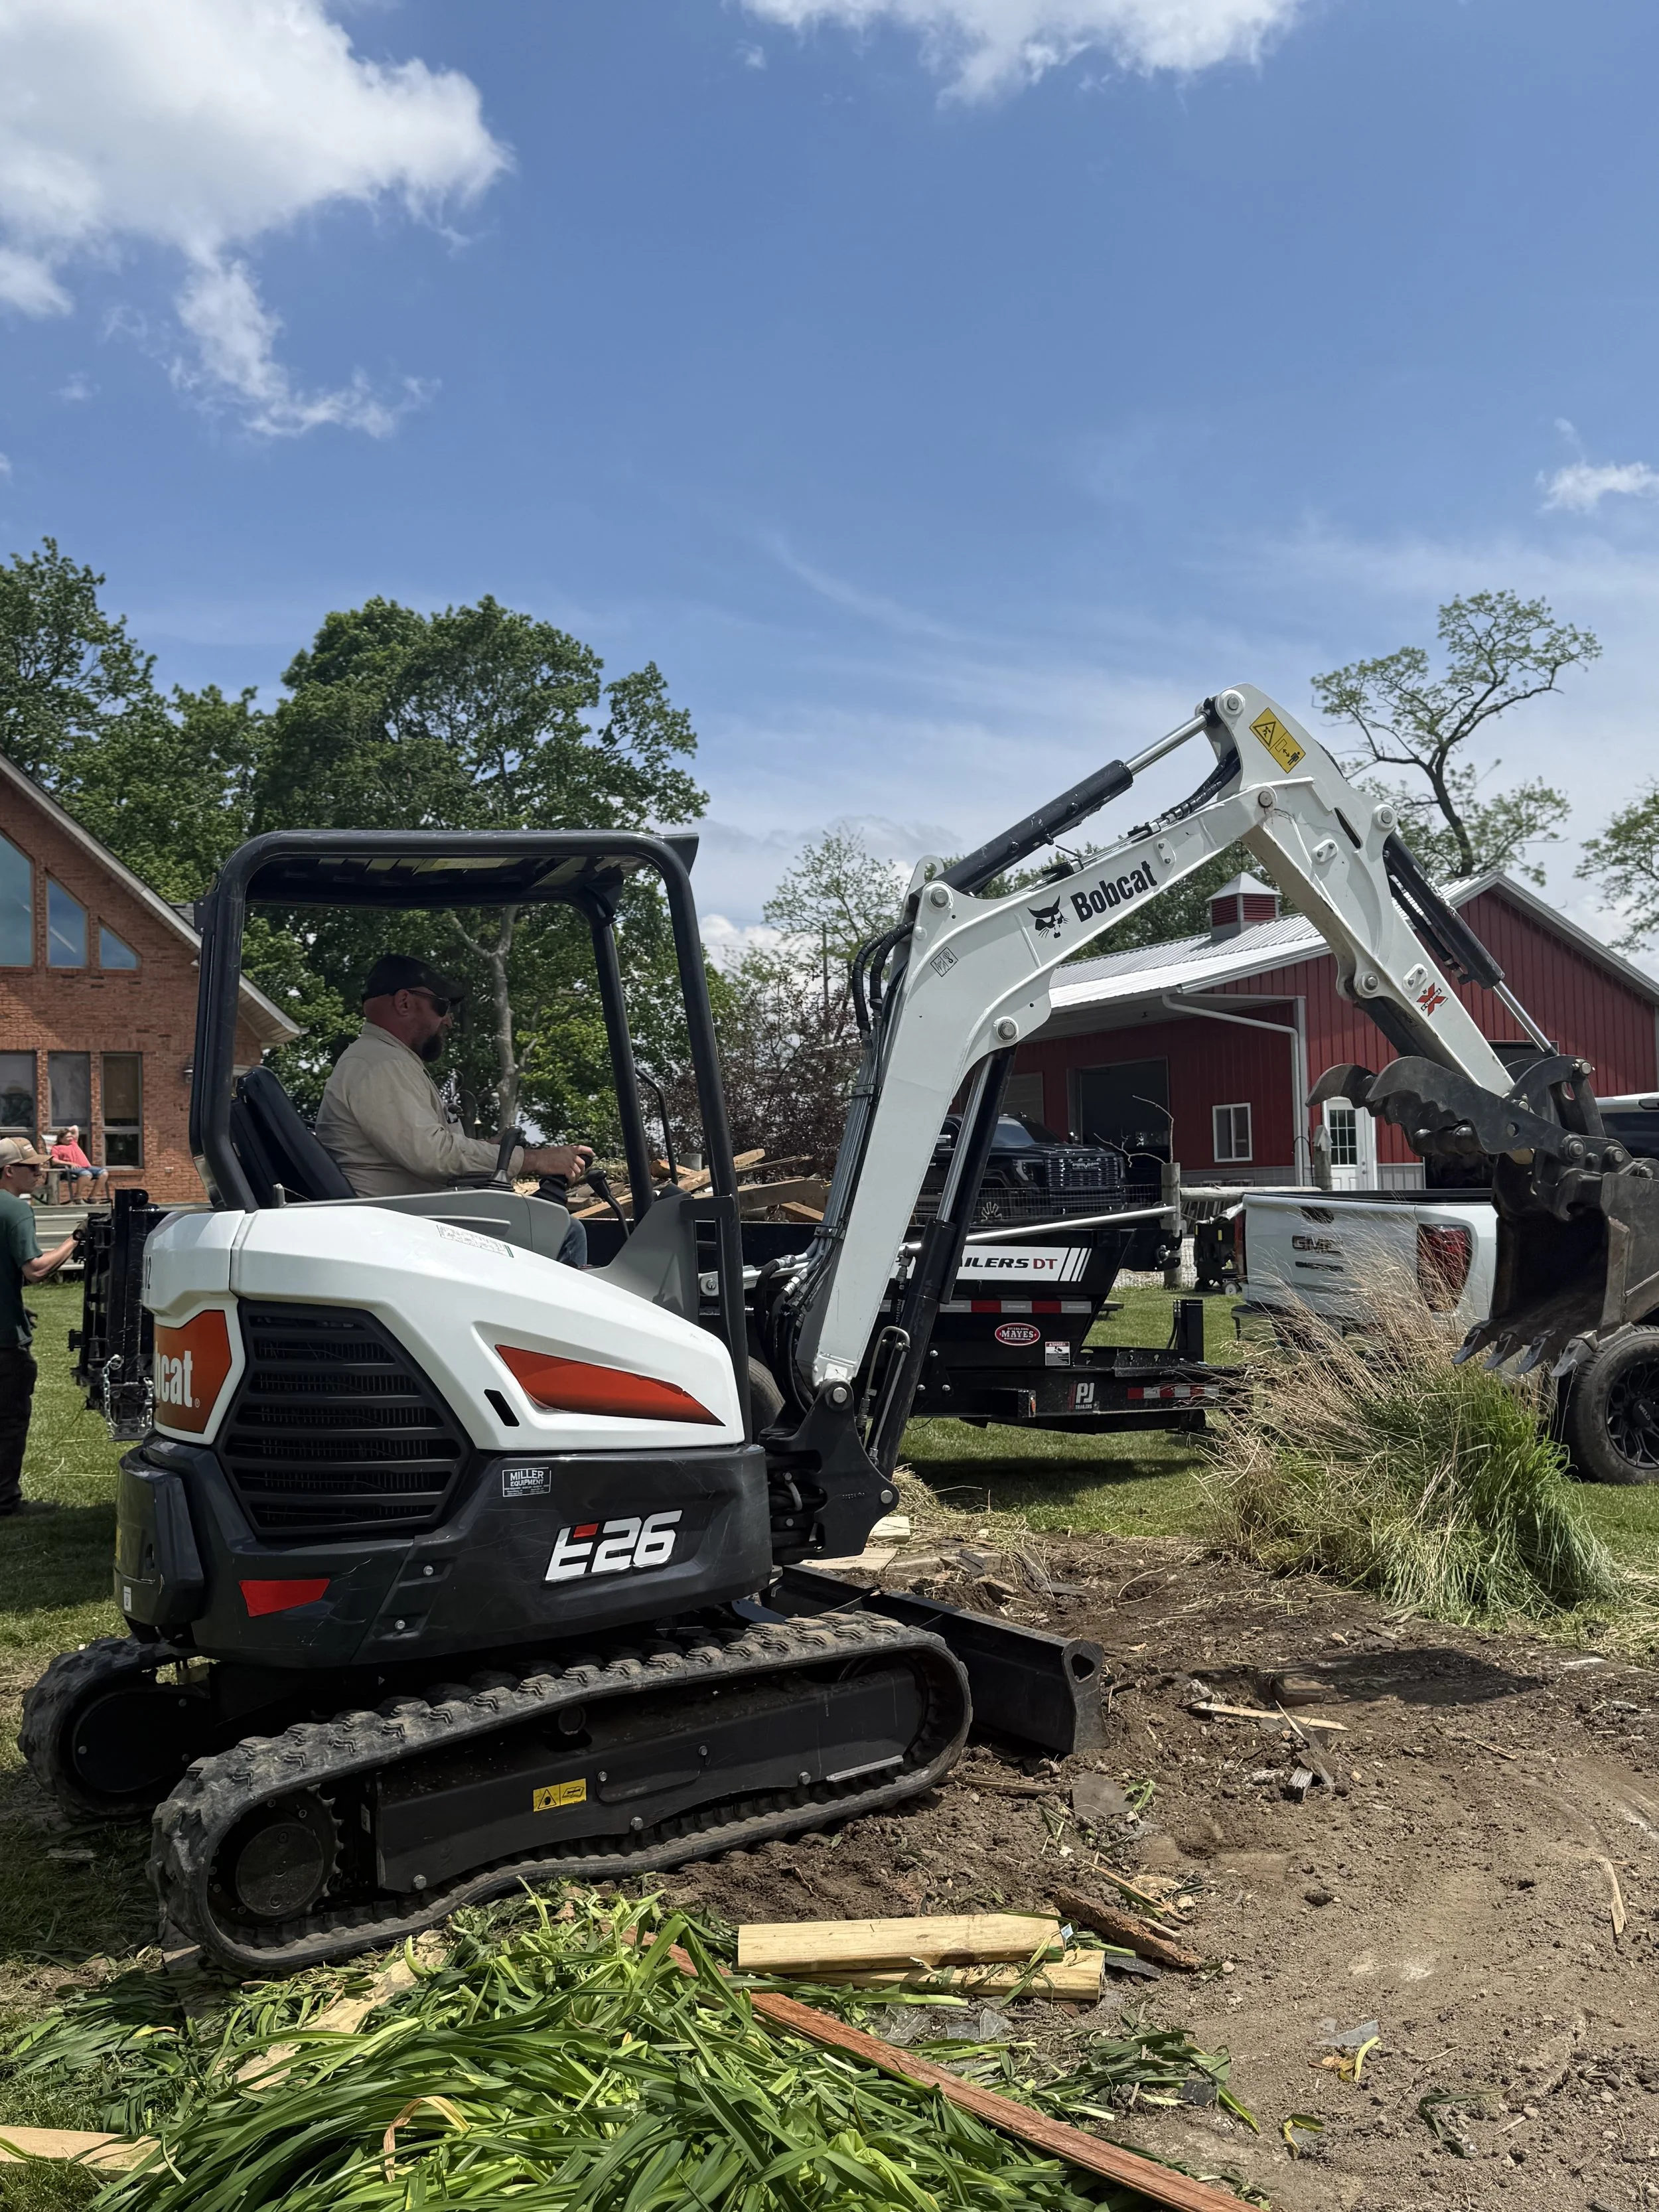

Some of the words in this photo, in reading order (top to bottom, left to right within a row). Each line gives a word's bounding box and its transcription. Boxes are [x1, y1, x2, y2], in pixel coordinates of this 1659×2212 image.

[1070, 860, 1157, 922] Bobcat
[1033, 1258, 1058, 1270] DT
[1001, 1330, 1034, 1339] MAYES
[1075, 1382, 1095, 1404] PJ
[510, 1469, 544, 1481] MILLER
[510, 1479, 544, 1487] EQUIPMENT
[545, 1510, 683, 1582] E26
